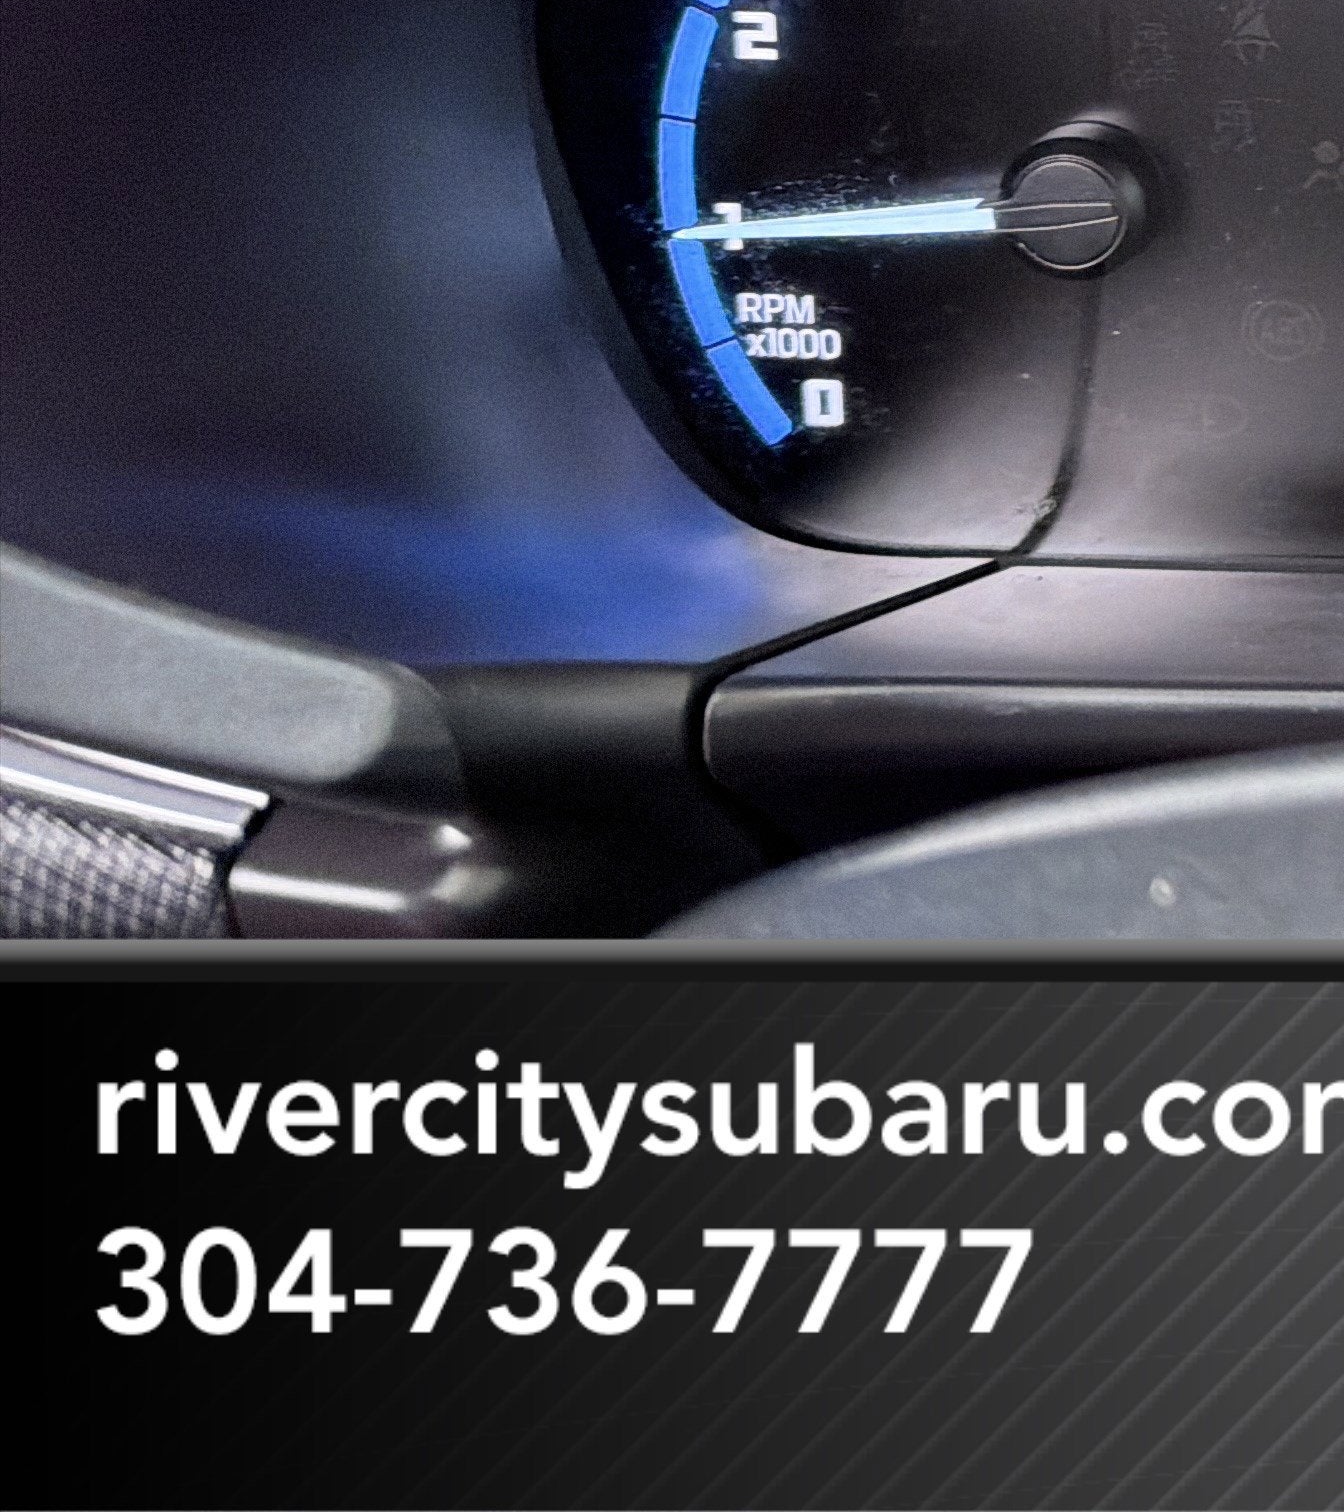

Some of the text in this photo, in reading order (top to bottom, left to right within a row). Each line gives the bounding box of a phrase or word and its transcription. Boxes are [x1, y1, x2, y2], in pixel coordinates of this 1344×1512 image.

[732, 11, 778, 60] 2
[712, 202, 744, 251] 1
[736, 292, 816, 324] RPM
[745, 327, 842, 360] x1000
[802, 379, 844, 427] 0
